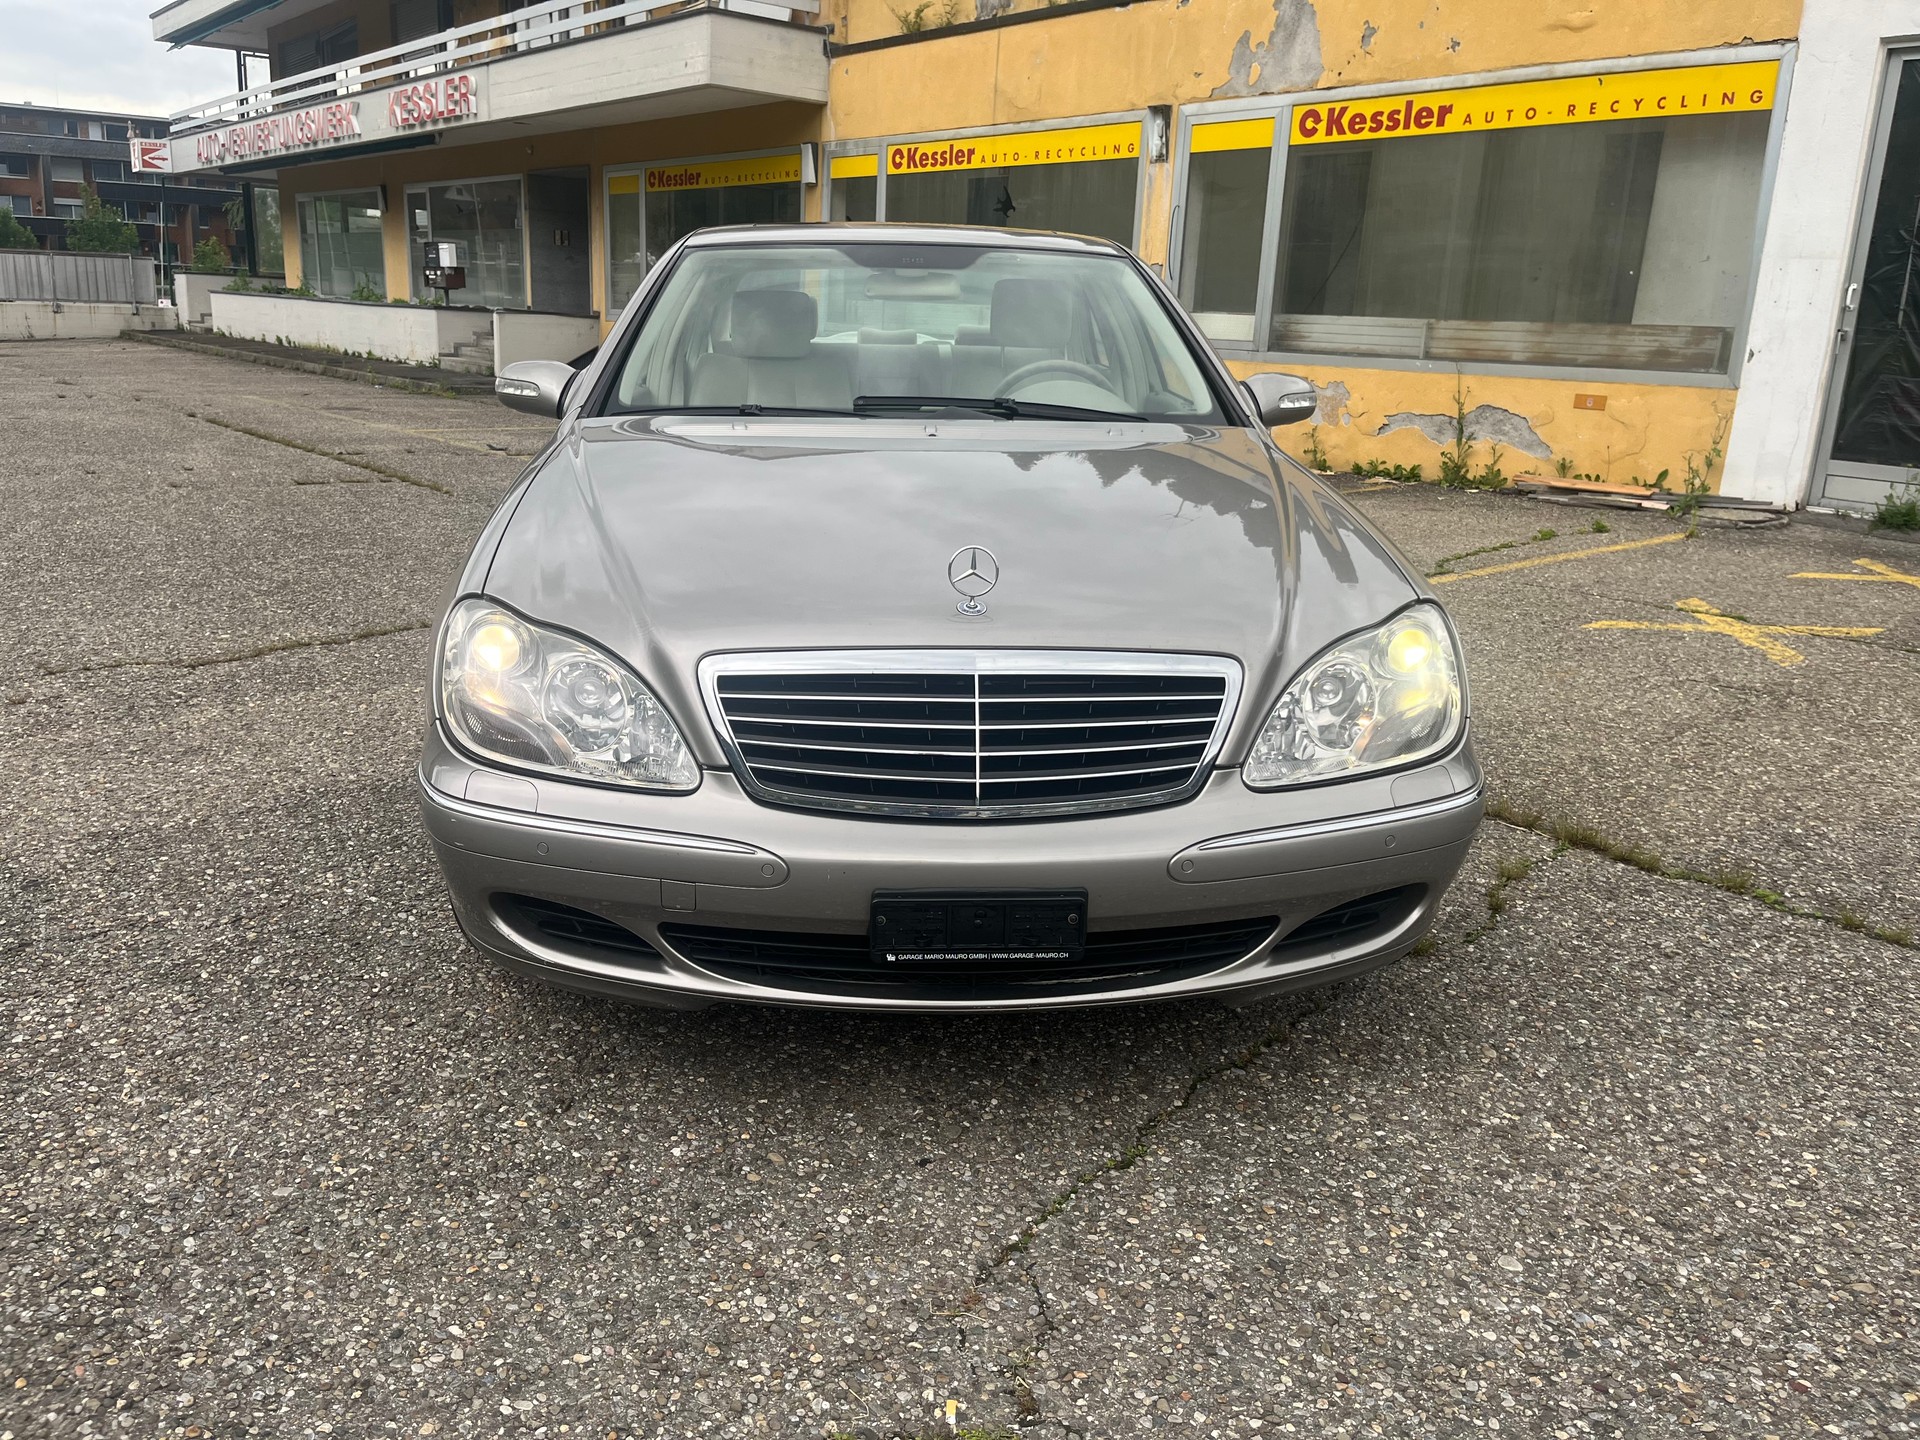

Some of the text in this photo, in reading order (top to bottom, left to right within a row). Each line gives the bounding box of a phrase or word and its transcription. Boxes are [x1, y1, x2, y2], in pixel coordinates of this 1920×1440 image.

[197, 101, 361, 163] AUTO-VERWERTUNGSWERK
[387, 75, 478, 127] KESSLER
[1325, 89, 1764, 137] Kessler AUTO-RECYCLING
[906, 142, 1136, 170] Kessler AUTO-RECYCLING
[657, 168, 702, 188] Kessler
[898, 953, 924, 961] GARAGE
[991, 952, 1069, 960] WWW.GARAGE-MAURO.CH
